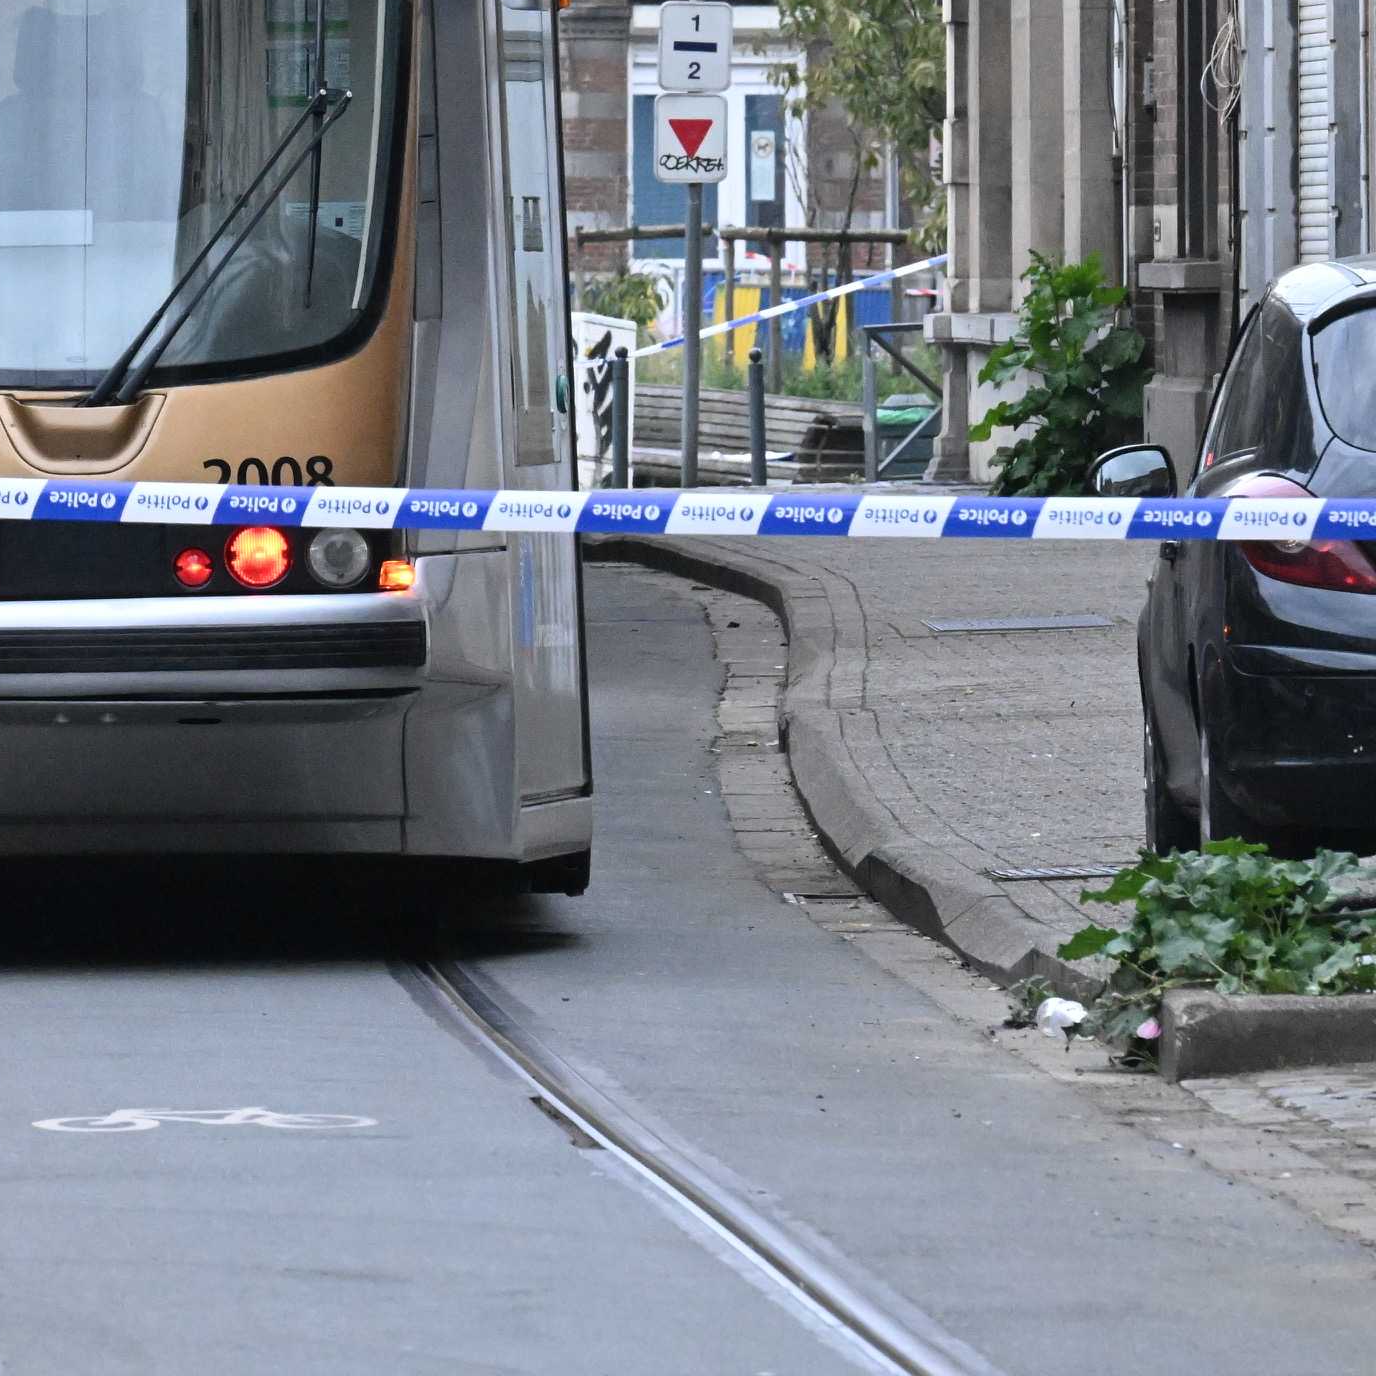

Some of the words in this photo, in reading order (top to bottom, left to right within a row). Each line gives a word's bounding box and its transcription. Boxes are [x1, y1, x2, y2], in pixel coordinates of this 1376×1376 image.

[691, 14, 701, 32] 1
[688, 61, 701, 80] 2
[203, 455, 334, 487] 2008
[49, 491, 97, 508] Police
[137, 494, 190, 511] Politie
[229, 495, 278, 512] Police
[318, 497, 371, 515] Politie
[410, 499, 459, 516] Police
[499, 501, 553, 519] Politie
[592, 503, 641, 521] Police
[681, 505, 736, 522] Politie
[776, 505, 824, 523] Police
[864, 506, 920, 524] Politie
[958, 507, 1008, 525] Police
[1049, 507, 1104, 525] Politie
[1144, 508, 1194, 526] Police
[1234, 508, 1289, 526] Politie
[1329, 509, 1376, 526] Police
